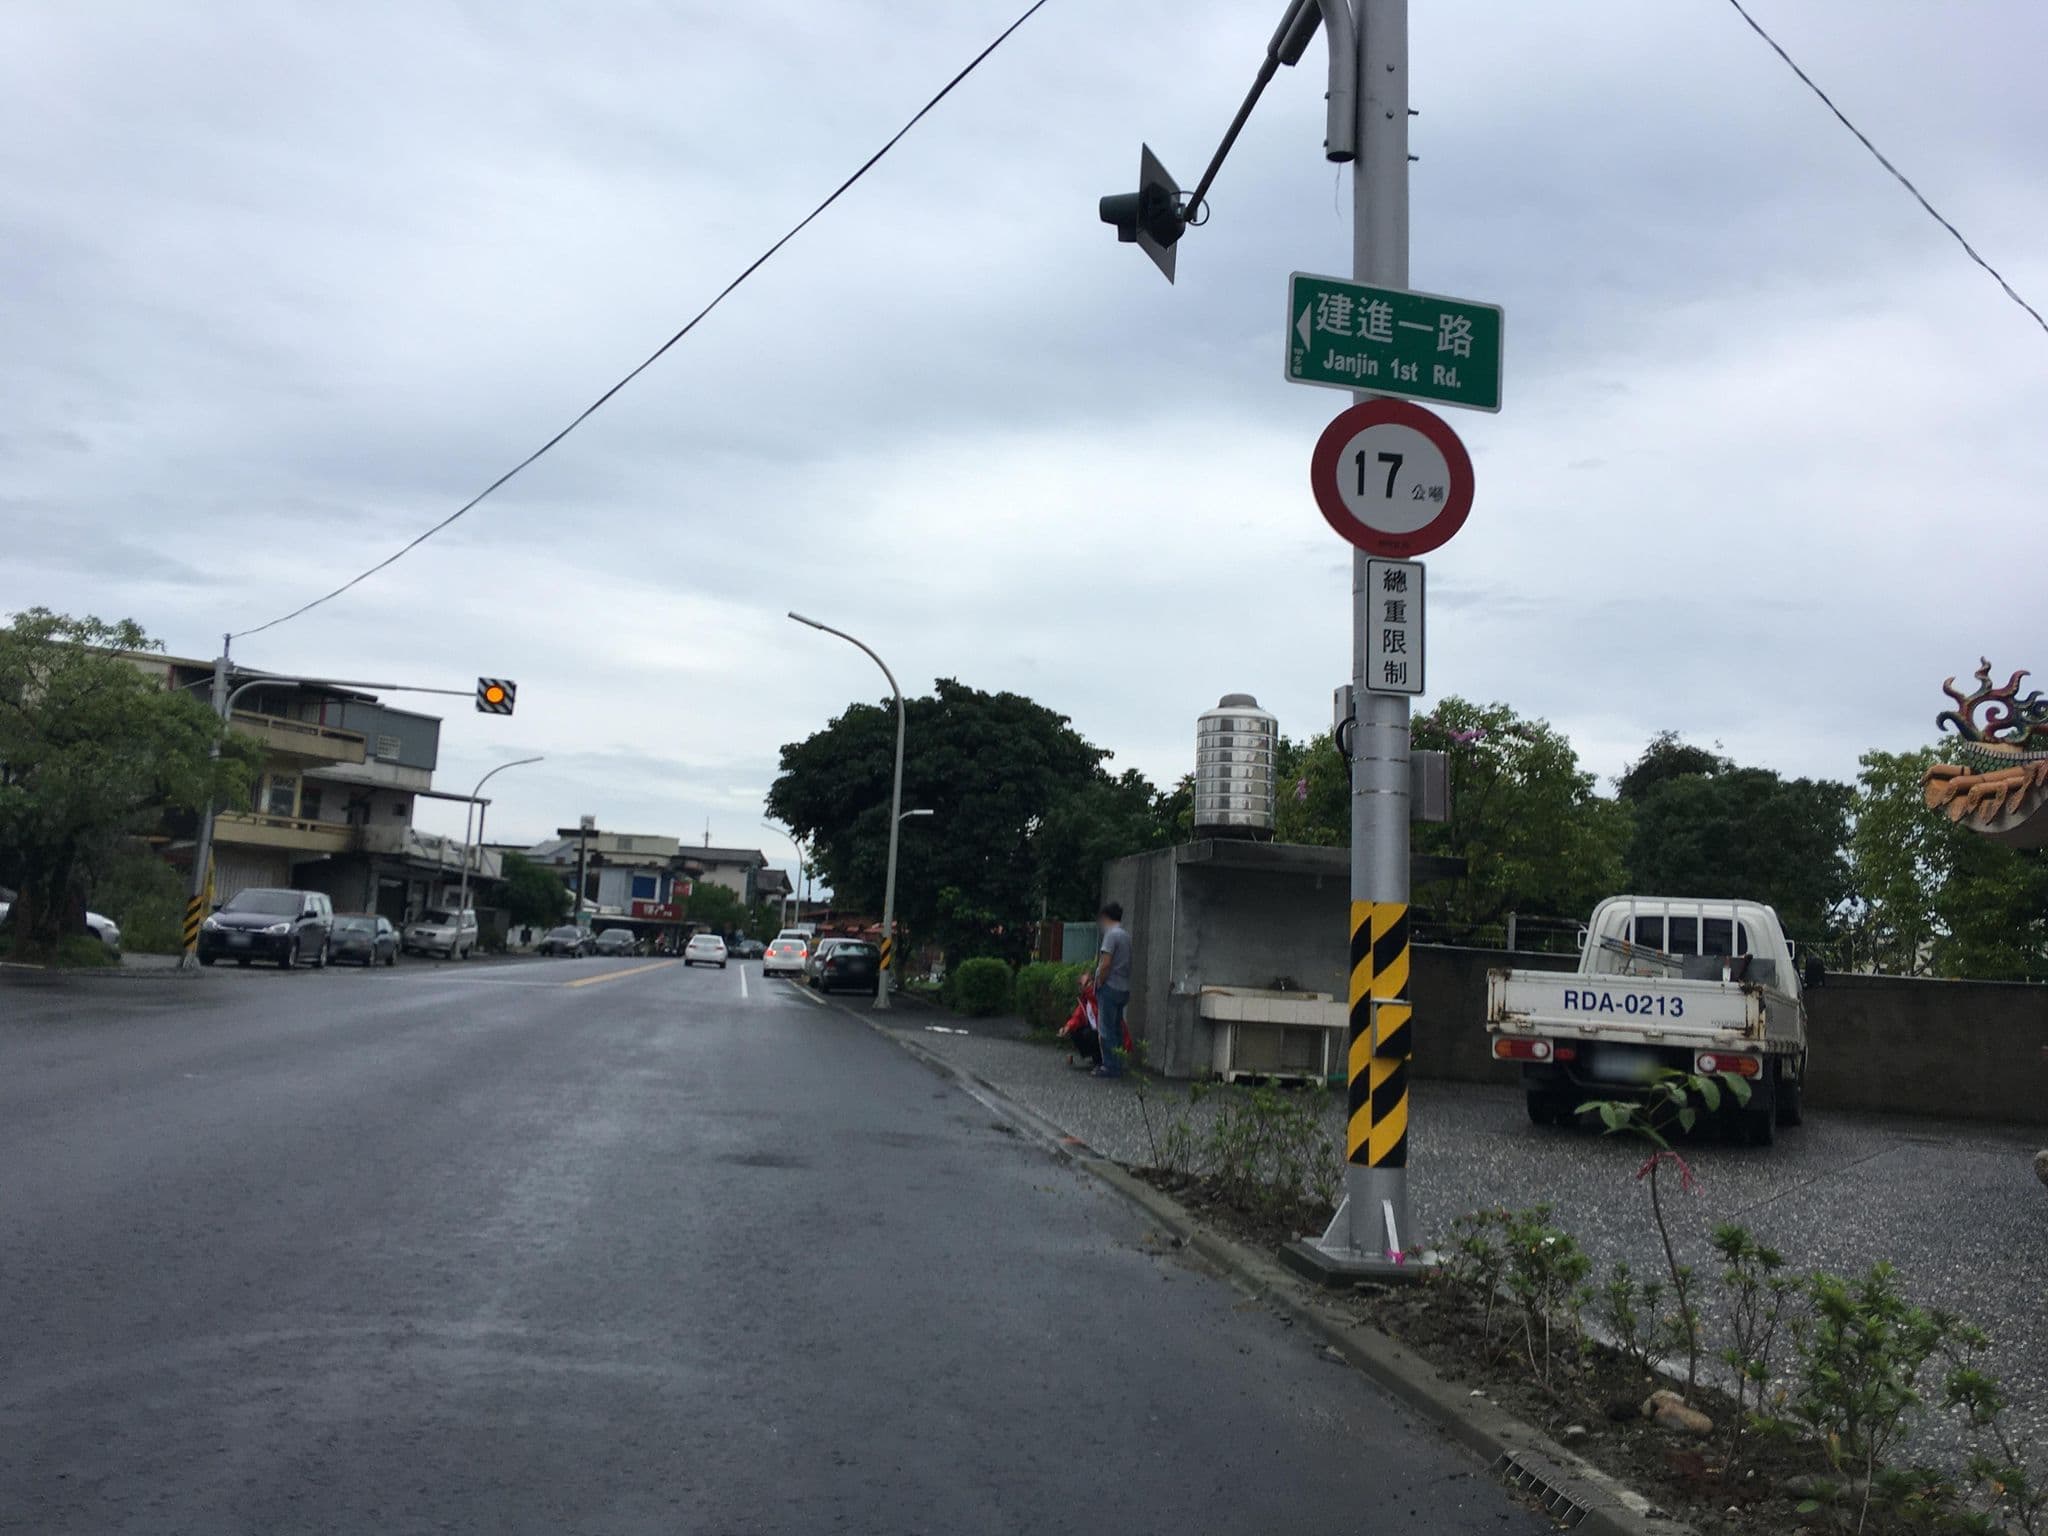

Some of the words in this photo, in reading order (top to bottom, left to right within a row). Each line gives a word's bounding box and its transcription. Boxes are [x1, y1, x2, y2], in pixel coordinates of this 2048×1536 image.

[1316, 292, 1475, 359] 建進一路
[1323, 348, 1379, 379] Janjin
[1390, 358, 1418, 382] 1st
[1432, 364, 1461, 388] Rd.
[1355, 450, 1403, 499] 17
[1383, 567, 1408, 685] 總重限制
[1564, 989, 1684, 1017] RDA-0213
